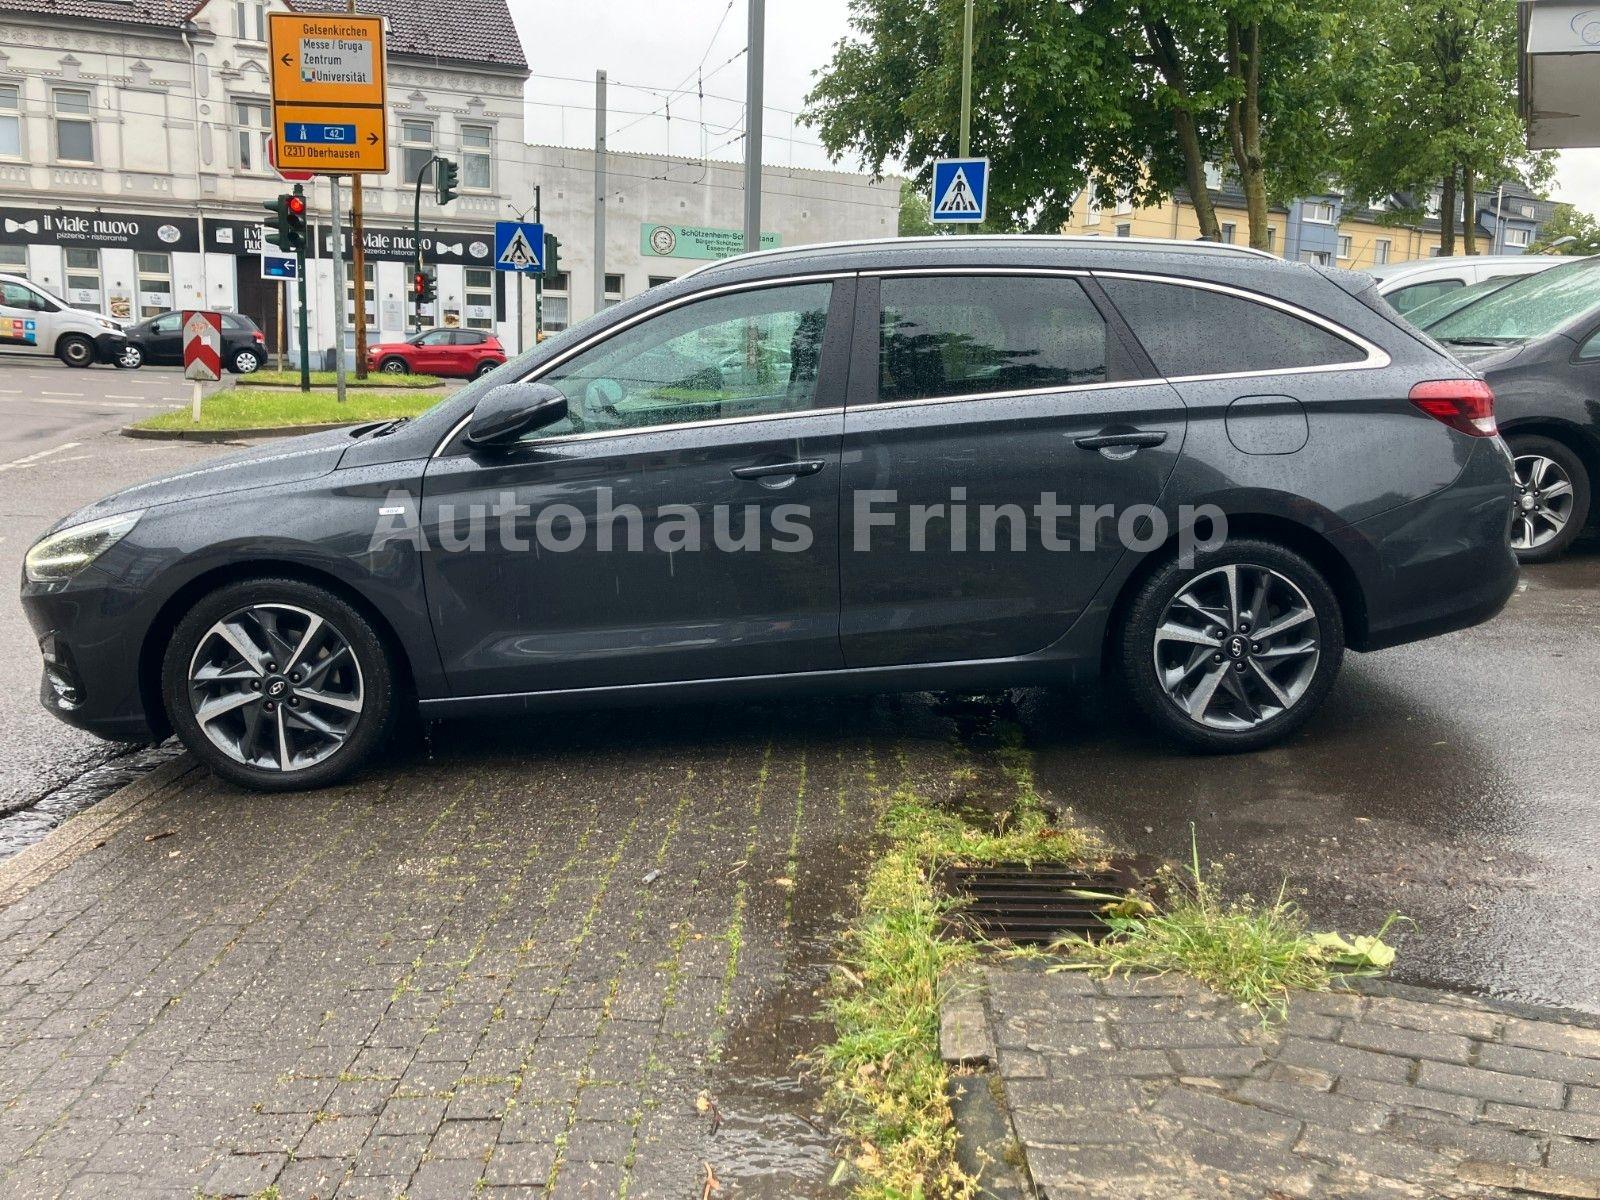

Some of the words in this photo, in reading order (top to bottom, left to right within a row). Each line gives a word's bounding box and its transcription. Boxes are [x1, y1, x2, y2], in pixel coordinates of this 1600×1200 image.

[303, 24, 367, 36] Gelsenkirchen
[303, 40, 330, 50] Messe
[338, 40, 363, 52] Gruga
[303, 53, 342, 65] Zentrum
[316, 71, 367, 83] Universität
[329, 129, 340, 138] 42
[286, 145, 303, 157] 231
[307, 148, 360, 159] Oberhausen
[44, 214, 52, 230] il
[55, 216, 89, 232] viale
[93, 220, 139, 235] nuovo
[56, 232, 85, 240] pizzeria
[91, 234, 128, 242] ristorante
